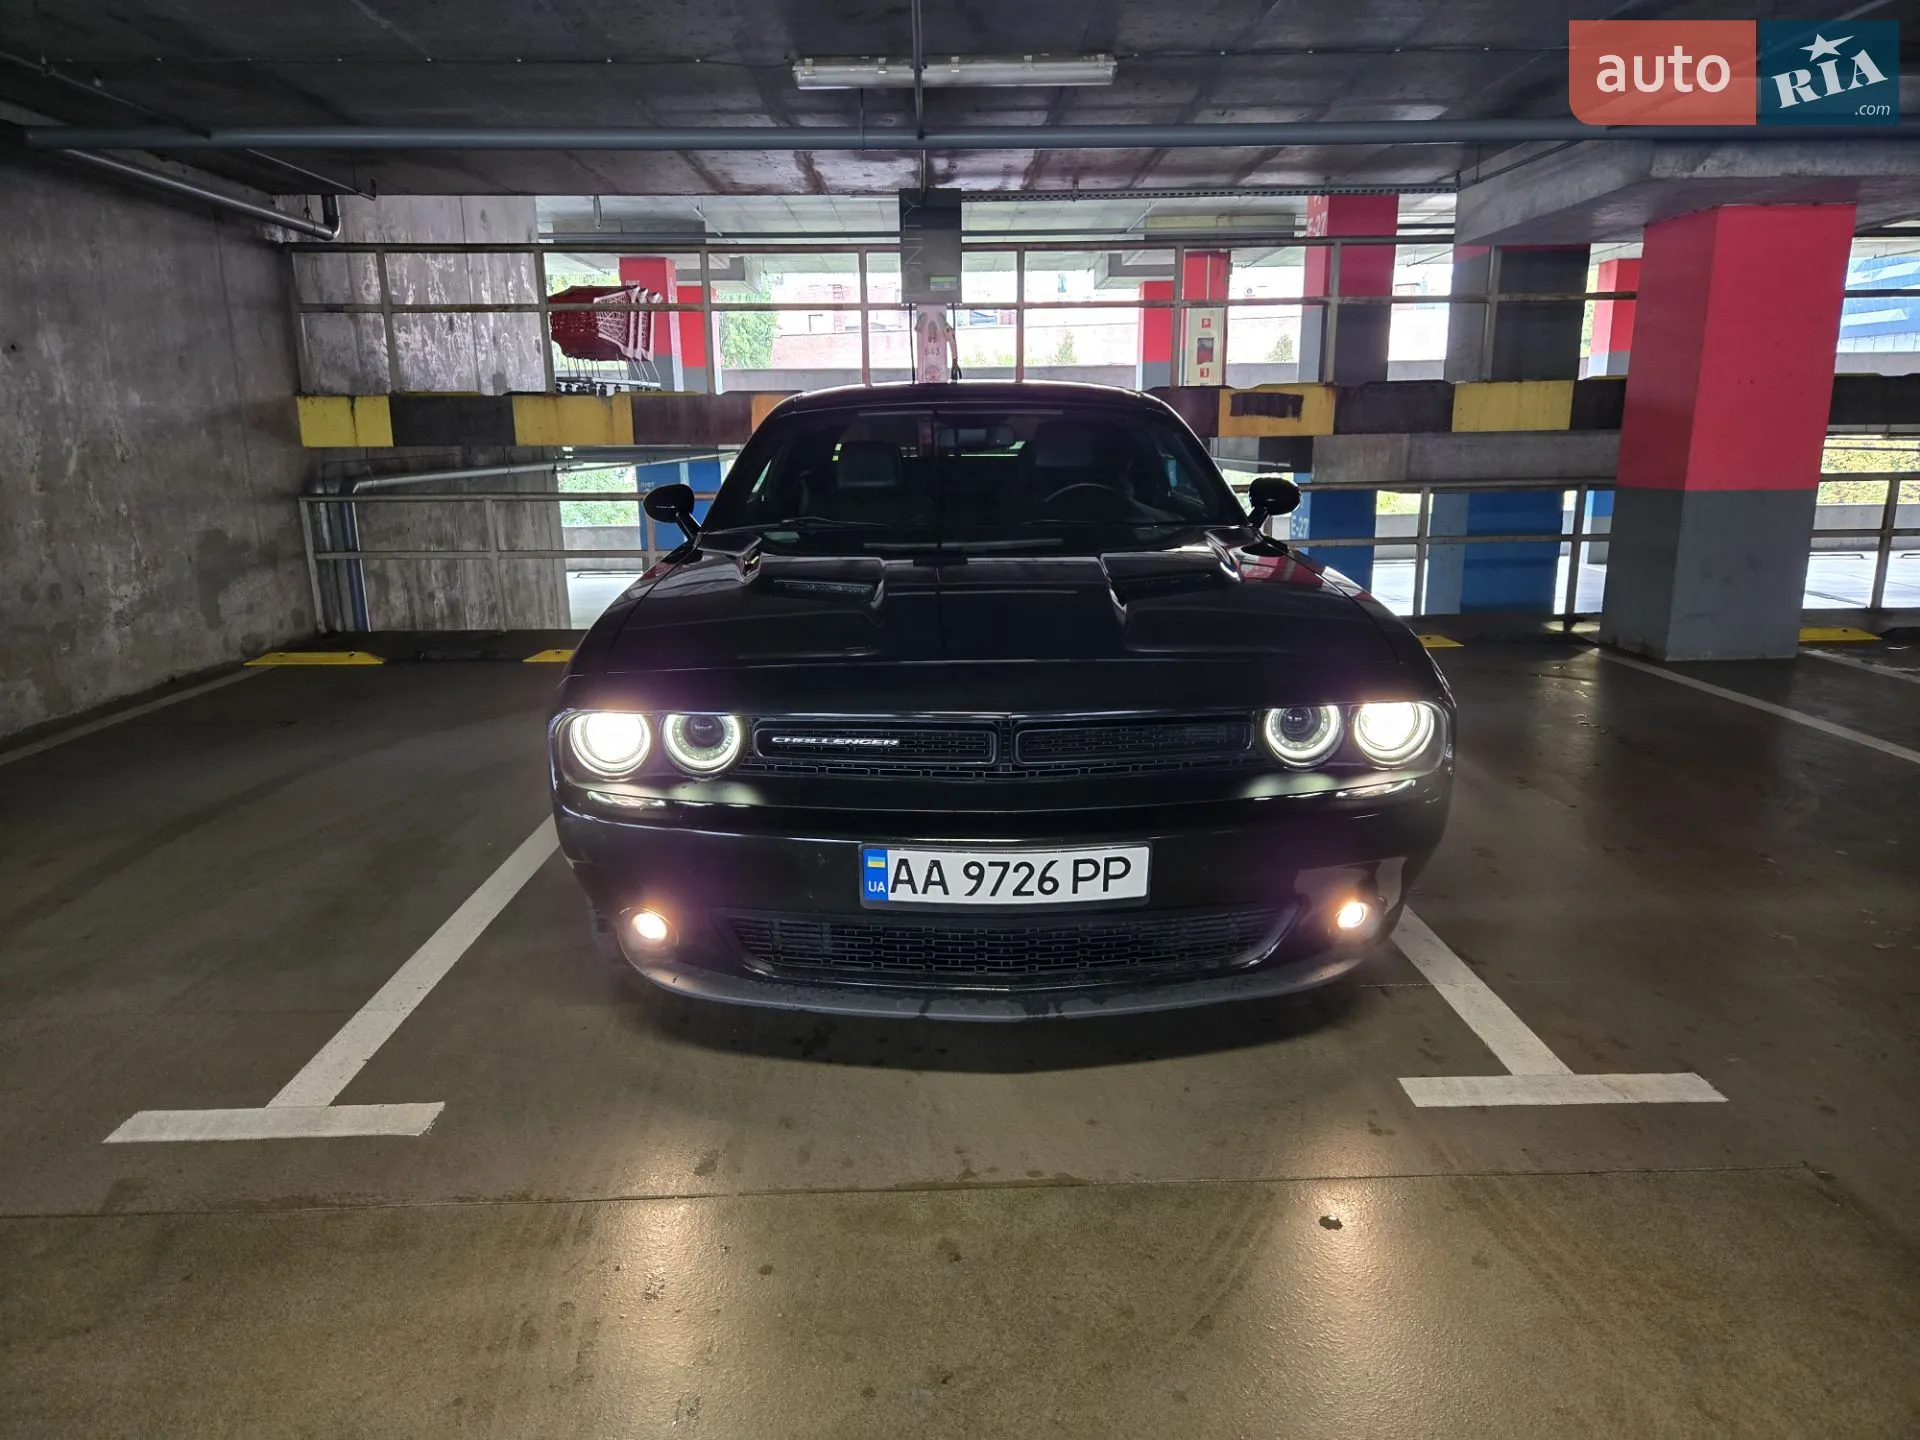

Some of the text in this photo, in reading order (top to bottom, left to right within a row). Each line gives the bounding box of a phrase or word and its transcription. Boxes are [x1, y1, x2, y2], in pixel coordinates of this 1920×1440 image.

[771, 736, 900, 747] CHALLENGER
[890, 856, 1132, 897] AA 9726 PP
[868, 881, 886, 893] UA
